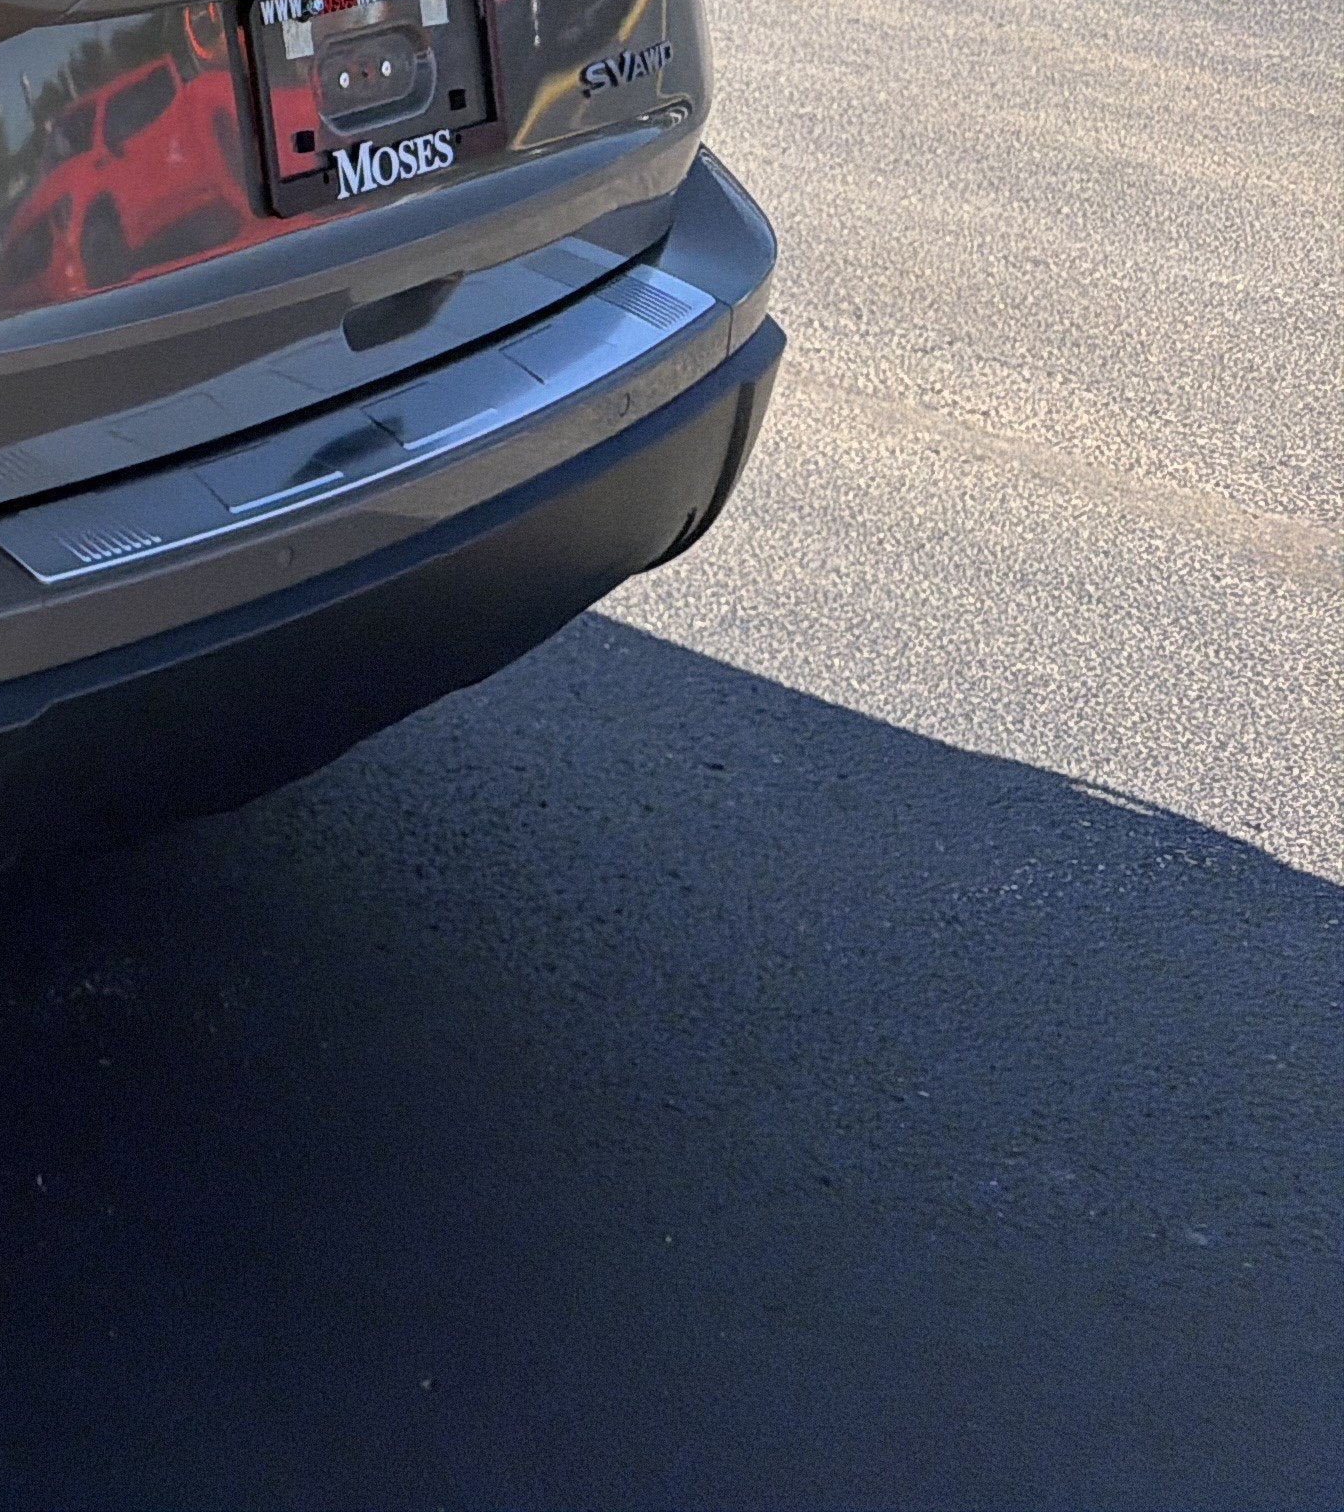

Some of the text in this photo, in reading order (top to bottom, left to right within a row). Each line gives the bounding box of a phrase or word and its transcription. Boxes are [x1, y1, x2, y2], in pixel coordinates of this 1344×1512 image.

[581, 41, 672, 98] SV AWD
[332, 129, 454, 200] MOSES
